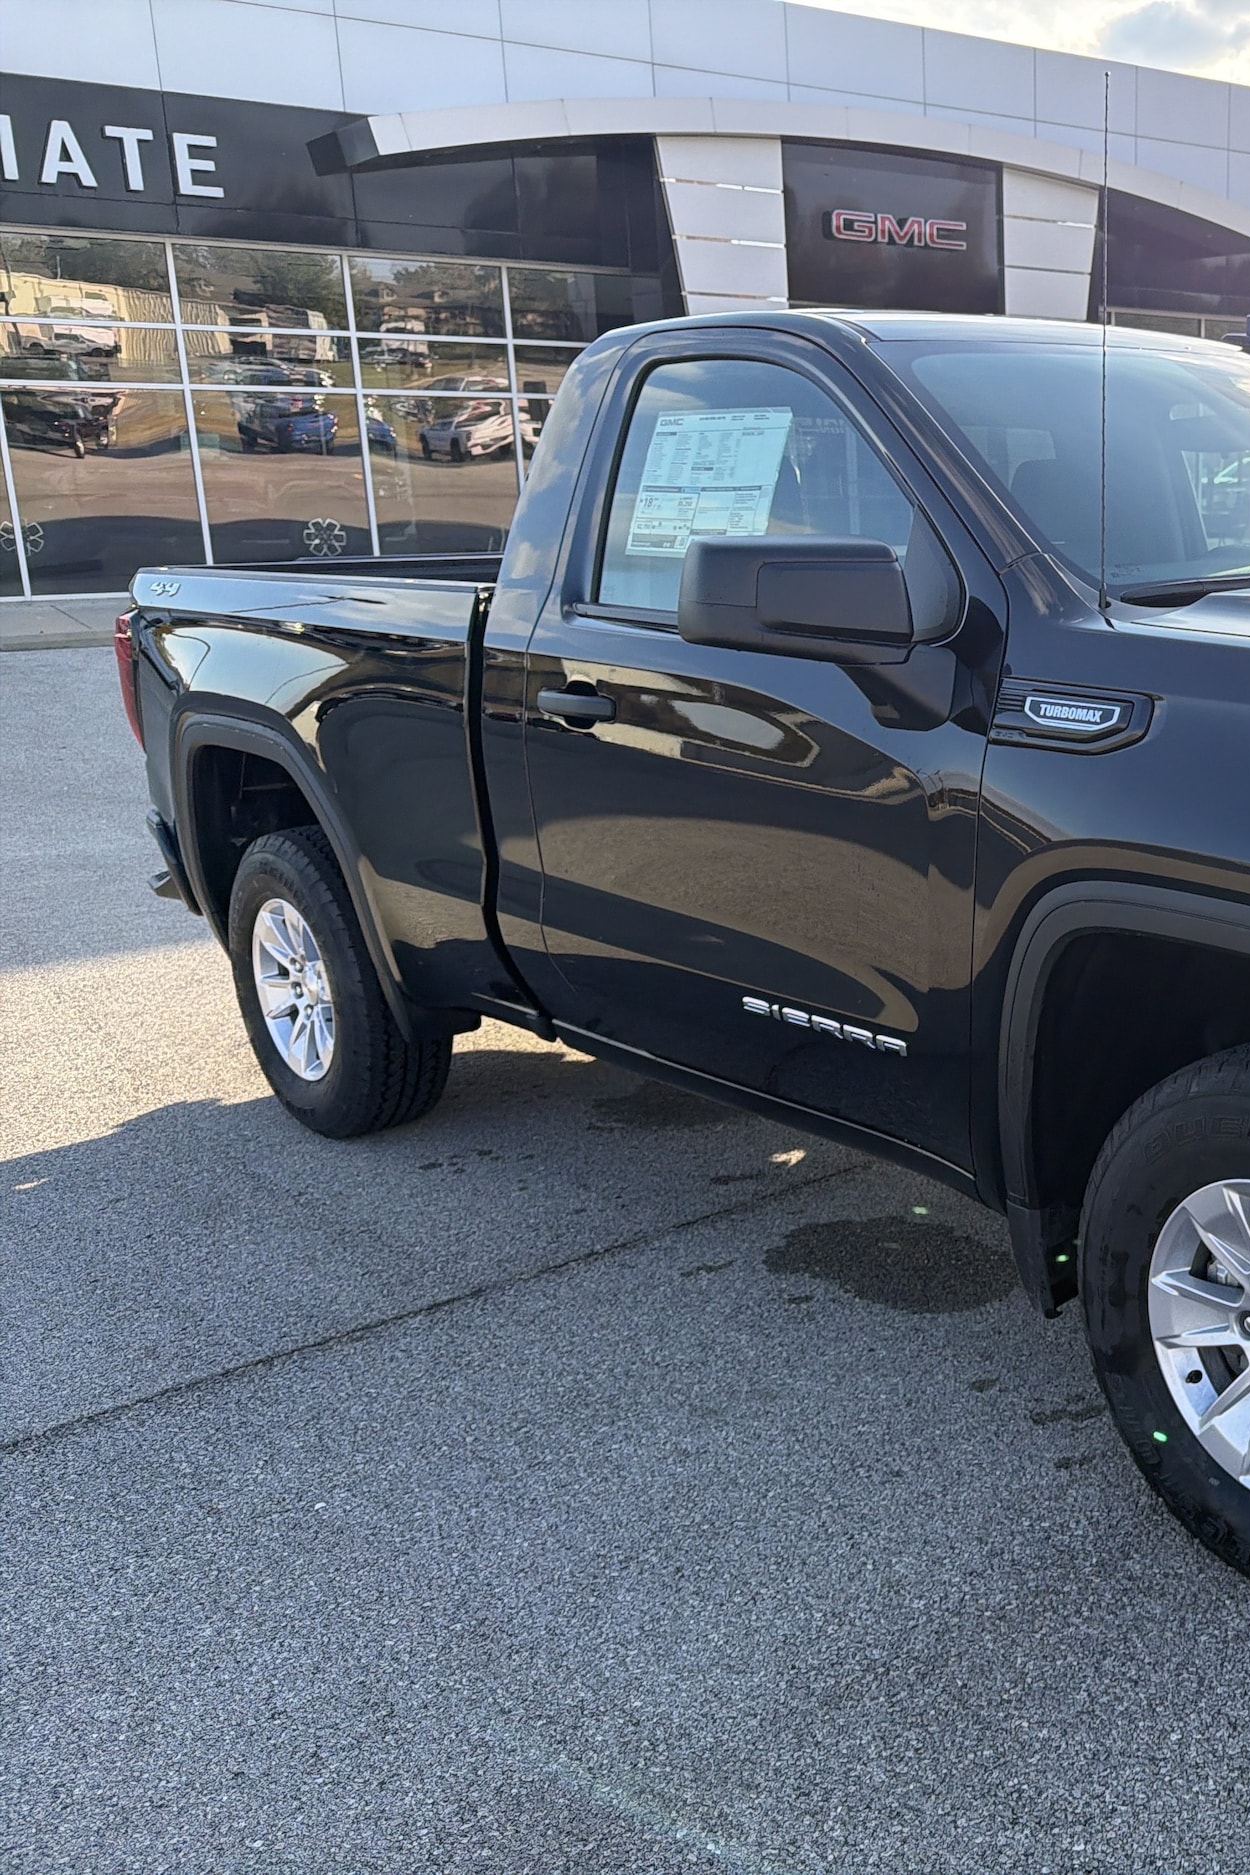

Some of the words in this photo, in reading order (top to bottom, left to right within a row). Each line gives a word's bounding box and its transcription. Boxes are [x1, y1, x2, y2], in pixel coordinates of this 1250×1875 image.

[832, 209, 967, 250] GMC
[660, 418, 684, 426] GMC
[150, 581, 181, 597] 4x4
[1039, 703, 1104, 722] TURBOMAX
[741, 995, 908, 1057] SIERRA
